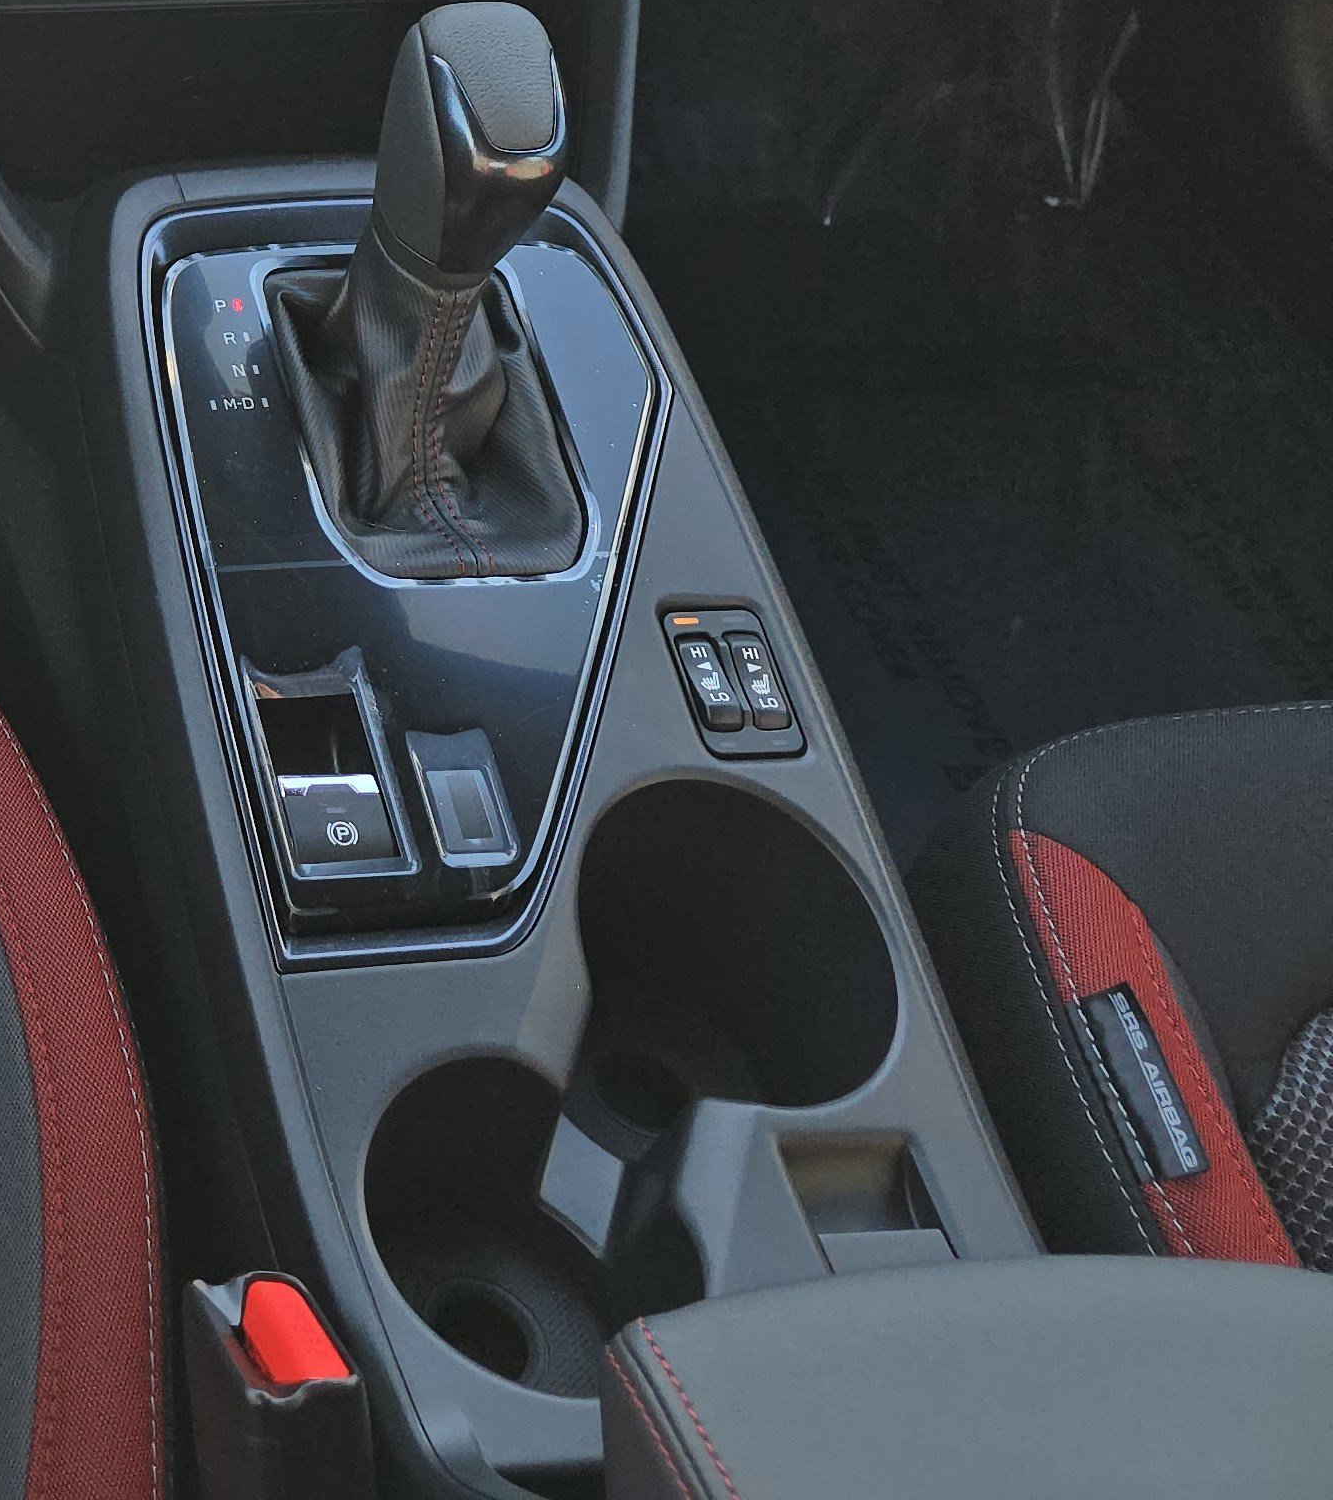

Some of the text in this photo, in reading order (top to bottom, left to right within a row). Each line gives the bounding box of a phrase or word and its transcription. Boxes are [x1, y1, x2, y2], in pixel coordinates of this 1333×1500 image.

[214, 299, 227, 313] P
[222, 331, 237, 345] R
[231, 363, 246, 377] N
[689, 646, 708, 659] HI
[741, 647, 760, 660] HI
[709, 691, 730, 702] LO
[758, 697, 779, 709] LO
[1113, 991, 1198, 1169] SRS AIRBAG
